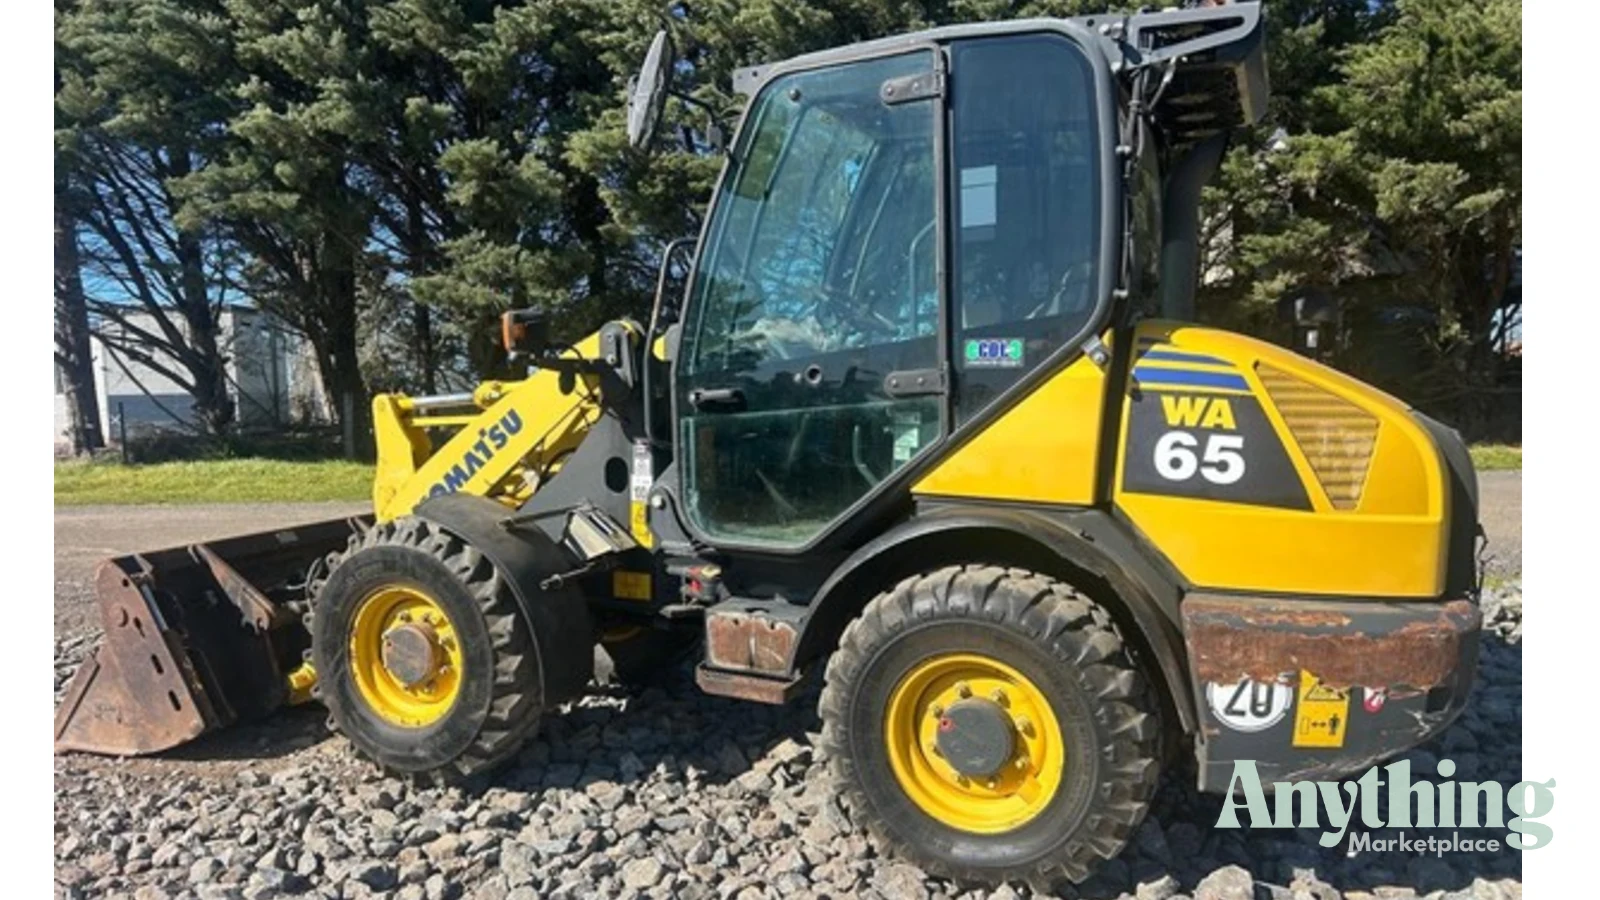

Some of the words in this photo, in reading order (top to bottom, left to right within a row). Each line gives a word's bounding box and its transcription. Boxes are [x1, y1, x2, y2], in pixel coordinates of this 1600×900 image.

[1160, 395, 1237, 430] WA
[418, 408, 523, 500] OMATSU
[1153, 430, 1246, 485] 65
